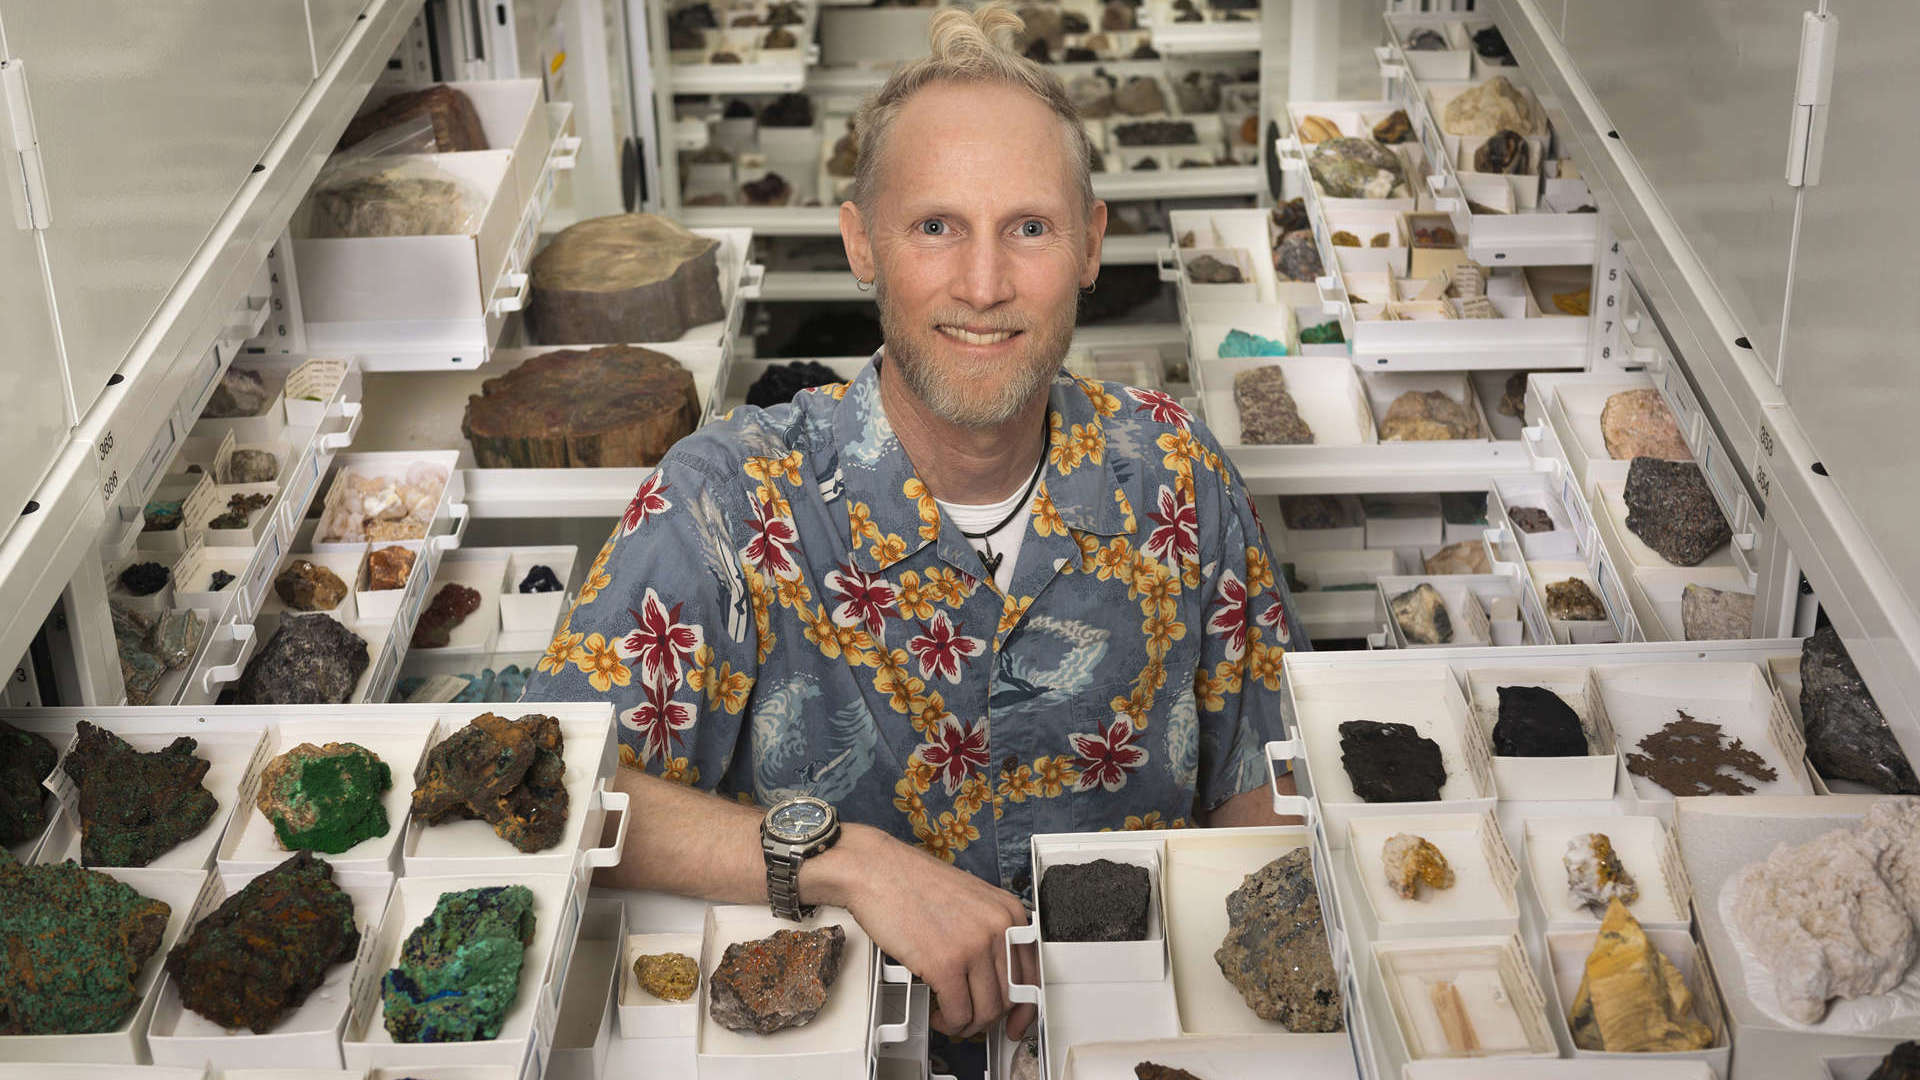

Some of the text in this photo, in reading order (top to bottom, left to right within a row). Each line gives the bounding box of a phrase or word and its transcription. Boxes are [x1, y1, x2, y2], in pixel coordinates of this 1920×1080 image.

[1611, 242, 1619, 254] 4
[1608, 269, 1616, 281] 5
[274, 298, 283, 311] 5
[1606, 295, 1614, 307] 6
[278, 325, 287, 337] 6
[1605, 321, 1613, 333] 7
[1602, 347, 1610, 359] 8
[99, 431, 114, 461] 365
[1760, 425, 1773, 457] 353
[104, 470, 118, 501] 366
[1757, 465, 1770, 497] 354
